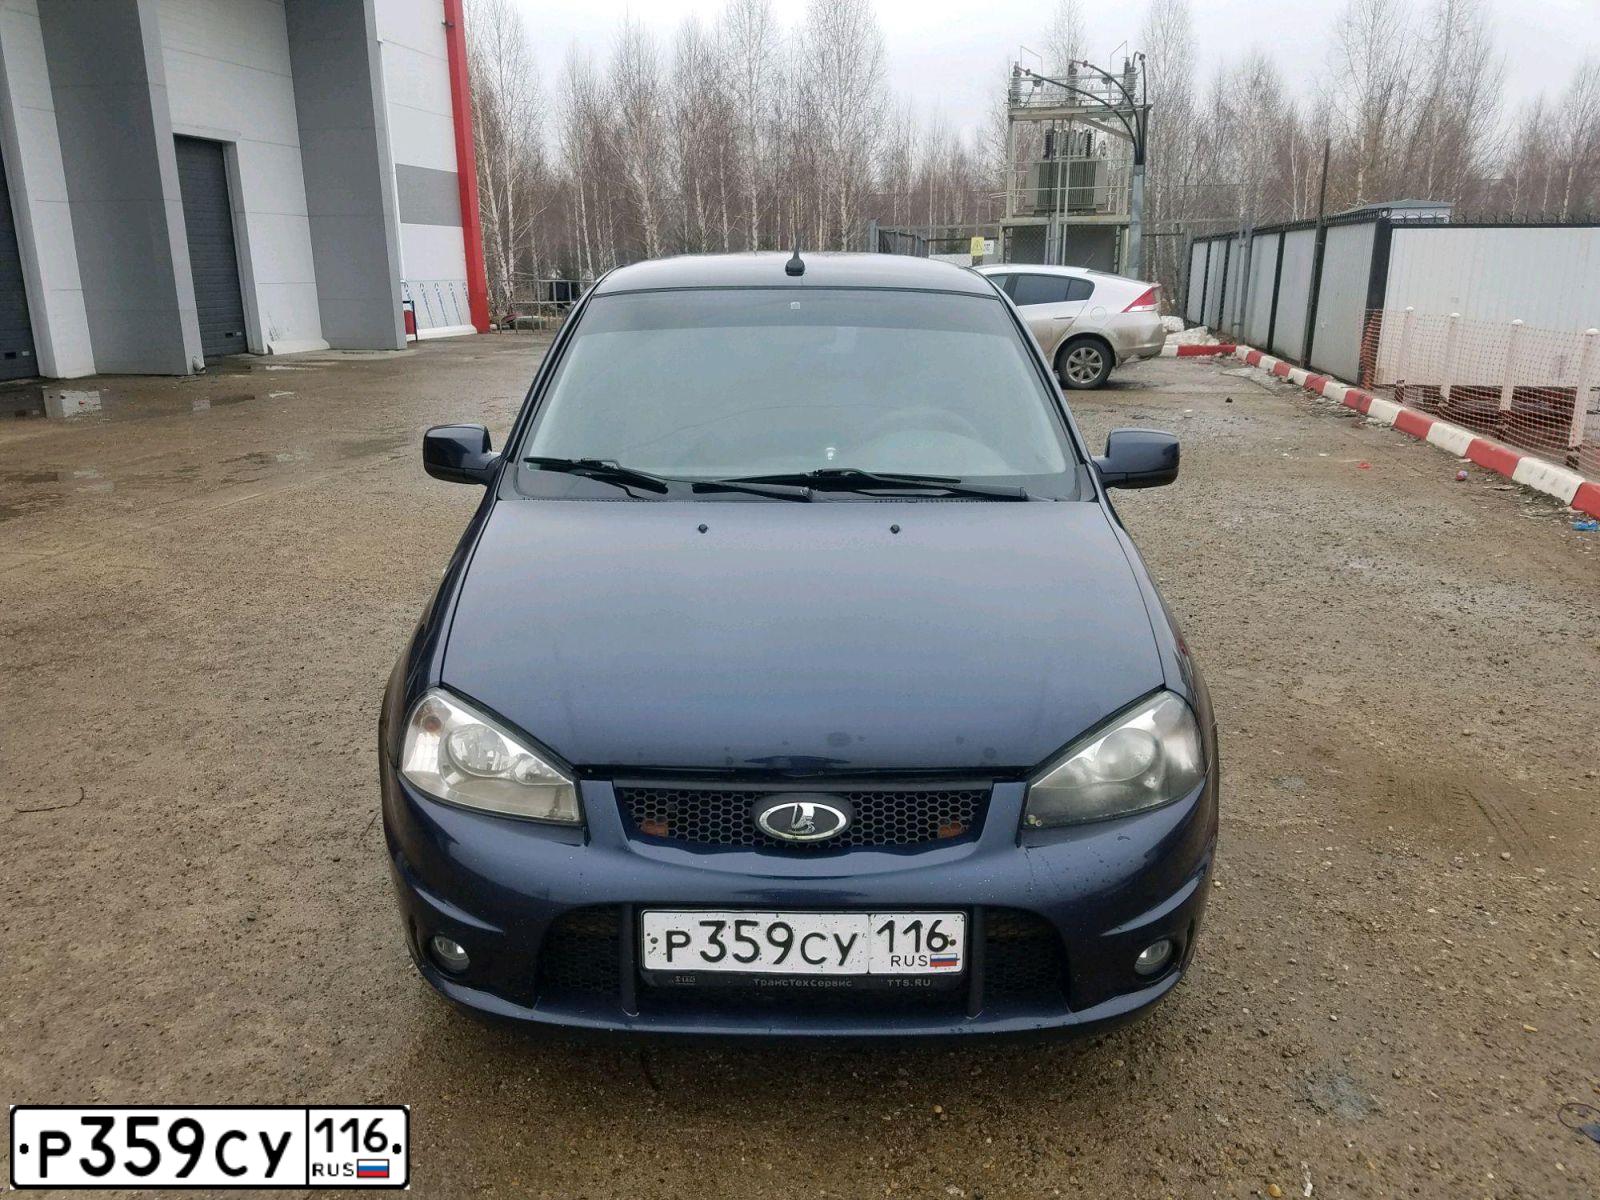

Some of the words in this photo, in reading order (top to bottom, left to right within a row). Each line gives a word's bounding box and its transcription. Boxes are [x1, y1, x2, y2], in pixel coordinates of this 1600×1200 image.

[876, 919, 949, 953] 116
[890, 955, 928, 967] RUS
[887, 979, 931, 988] TTS.RU
